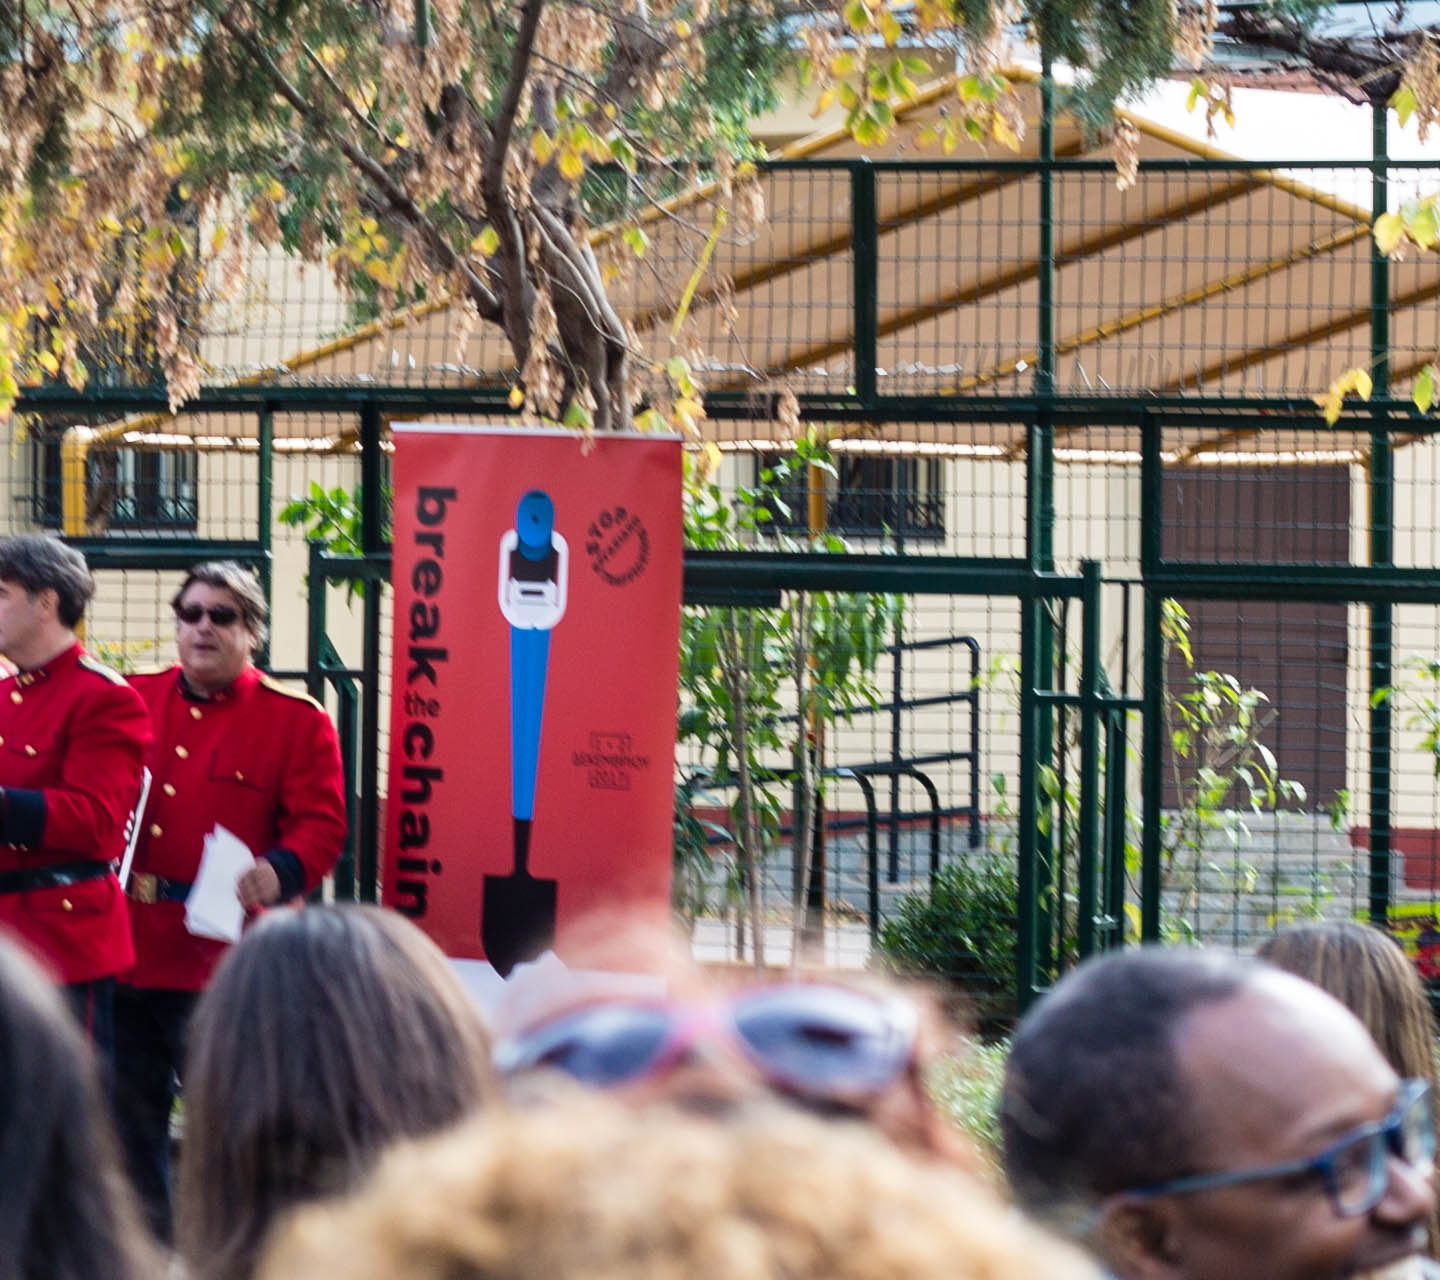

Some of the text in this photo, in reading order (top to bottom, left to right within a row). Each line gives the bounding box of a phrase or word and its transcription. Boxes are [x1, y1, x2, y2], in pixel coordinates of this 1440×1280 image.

[585, 505, 628, 555] STOP
[395, 486, 458, 918] break the chain
